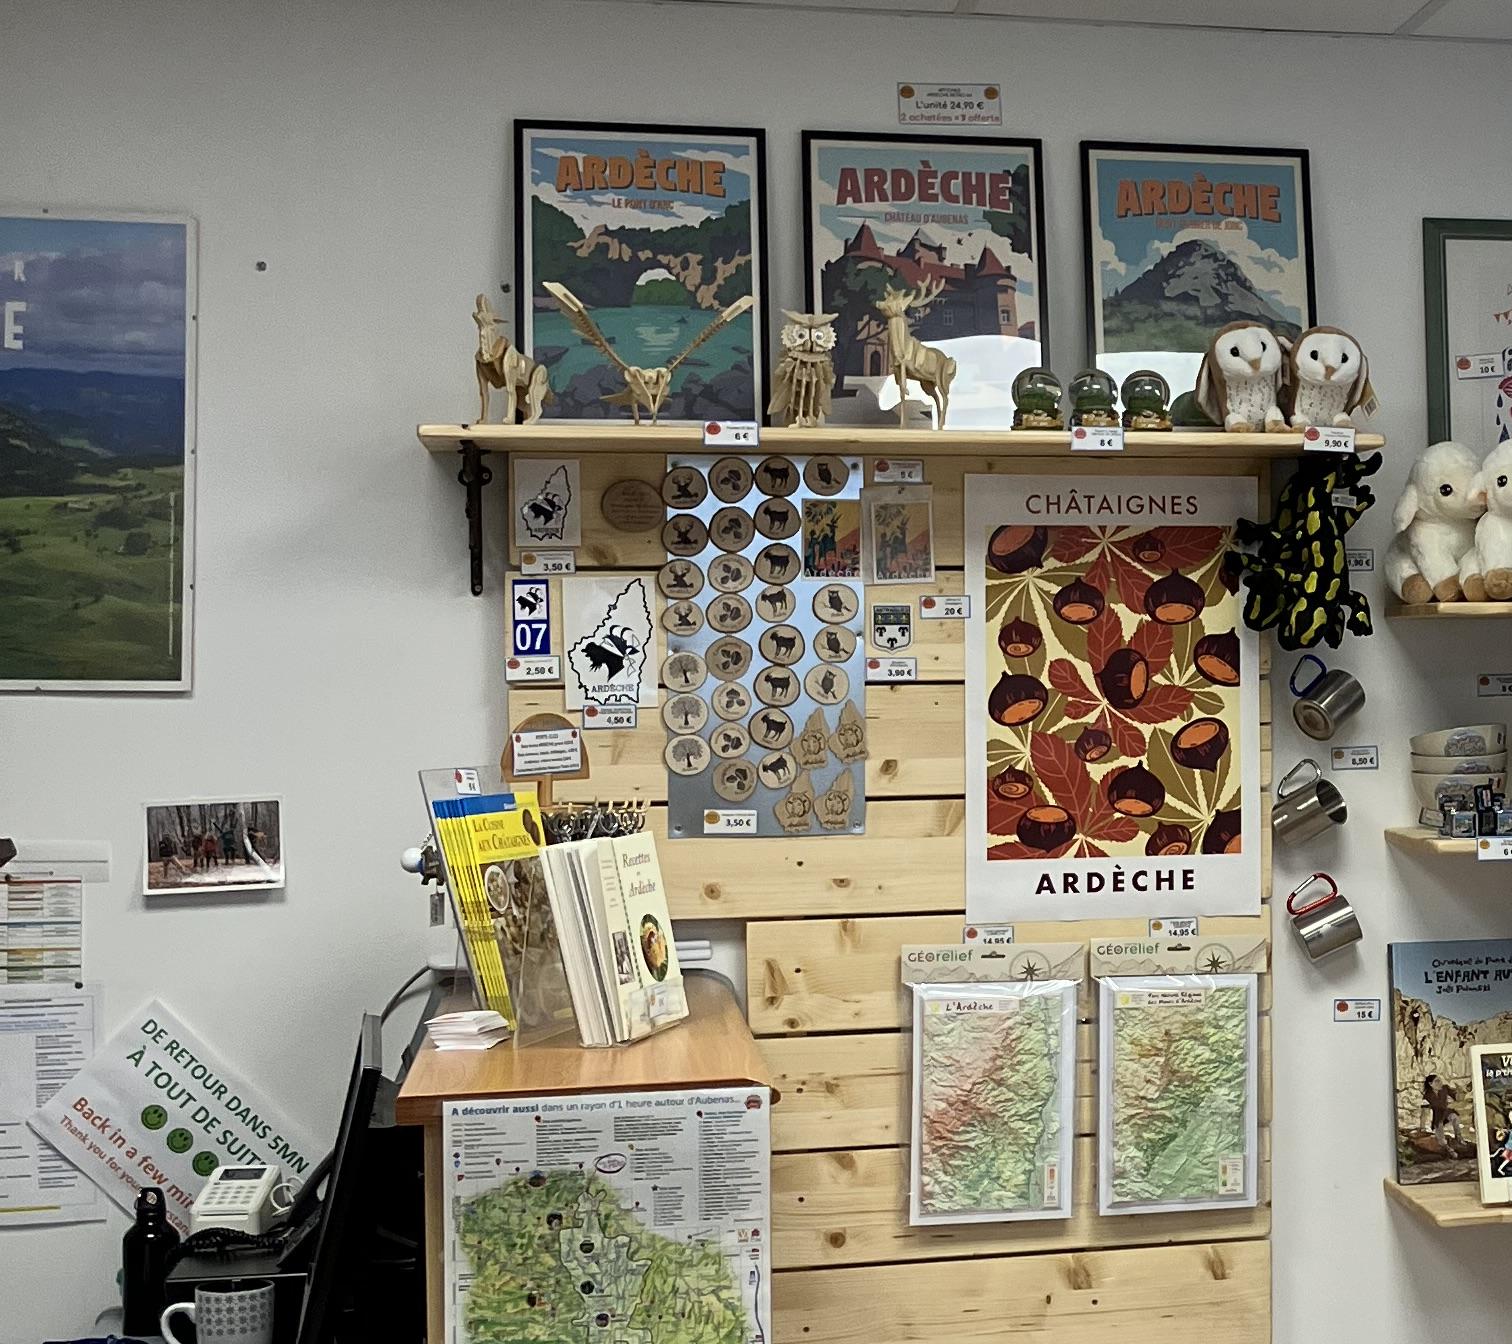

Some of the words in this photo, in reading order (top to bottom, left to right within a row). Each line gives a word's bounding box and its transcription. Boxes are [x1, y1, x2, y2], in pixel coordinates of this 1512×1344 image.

[976, 101, 985, 110] €
[556, 147, 727, 198] ARDÈCHE
[836, 159, 1013, 213] ARDÈCHE
[1116, 170, 1282, 223] ARDÈCHE
[742, 432, 750, 441] €
[1106, 438, 1113, 447] €
[1341, 439, 1349, 449] €
[1025, 488, 1199, 515] CHÂTAIGNES
[564, 562, 571, 571] €
[956, 607, 963, 615] €
[514, 623, 547, 651] 07
[547, 666, 554, 675] €
[906, 668, 912, 677] €
[625, 716, 632, 725] €
[1368, 756, 1375, 766] €
[745, 818, 751, 827] €
[1035, 864, 1195, 895] ARDÈCHE
[1190, 928, 1197, 936] €
[1424, 968, 1490, 984] L'ENFANT
[1367, 1010, 1373, 1019] €
[126, 1044, 147, 1069] À
[144, 1060, 198, 1110] TOUT
[190, 1105, 222, 1135] DE
[141, 1018, 169, 1045] DE
[164, 1039, 229, 1102] RETOUR
[224, 1095, 273, 1140] DANS
[267, 1135, 310, 1175] 5MN
[452, 1107, 460, 1116] A
[461, 1104, 518, 1116] découvrir
[519, 1103, 540, 1114] aussi
[541, 1102, 564, 1113] dans
[566, 1103, 579, 1112] un
[580, 1101, 607, 1112] rayon
[625, 1098, 652, 1109] heure
[654, 1097, 685, 1107] autour
[60, 1114, 90, 1145] Thank
[86, 1139, 108, 1162] you
[104, 1155, 123, 1175] for
[72, 1097, 113, 1136] Back
[108, 1128, 127, 1149] in
[125, 1146, 139, 1160] a
[137, 1156, 170, 1185] few
